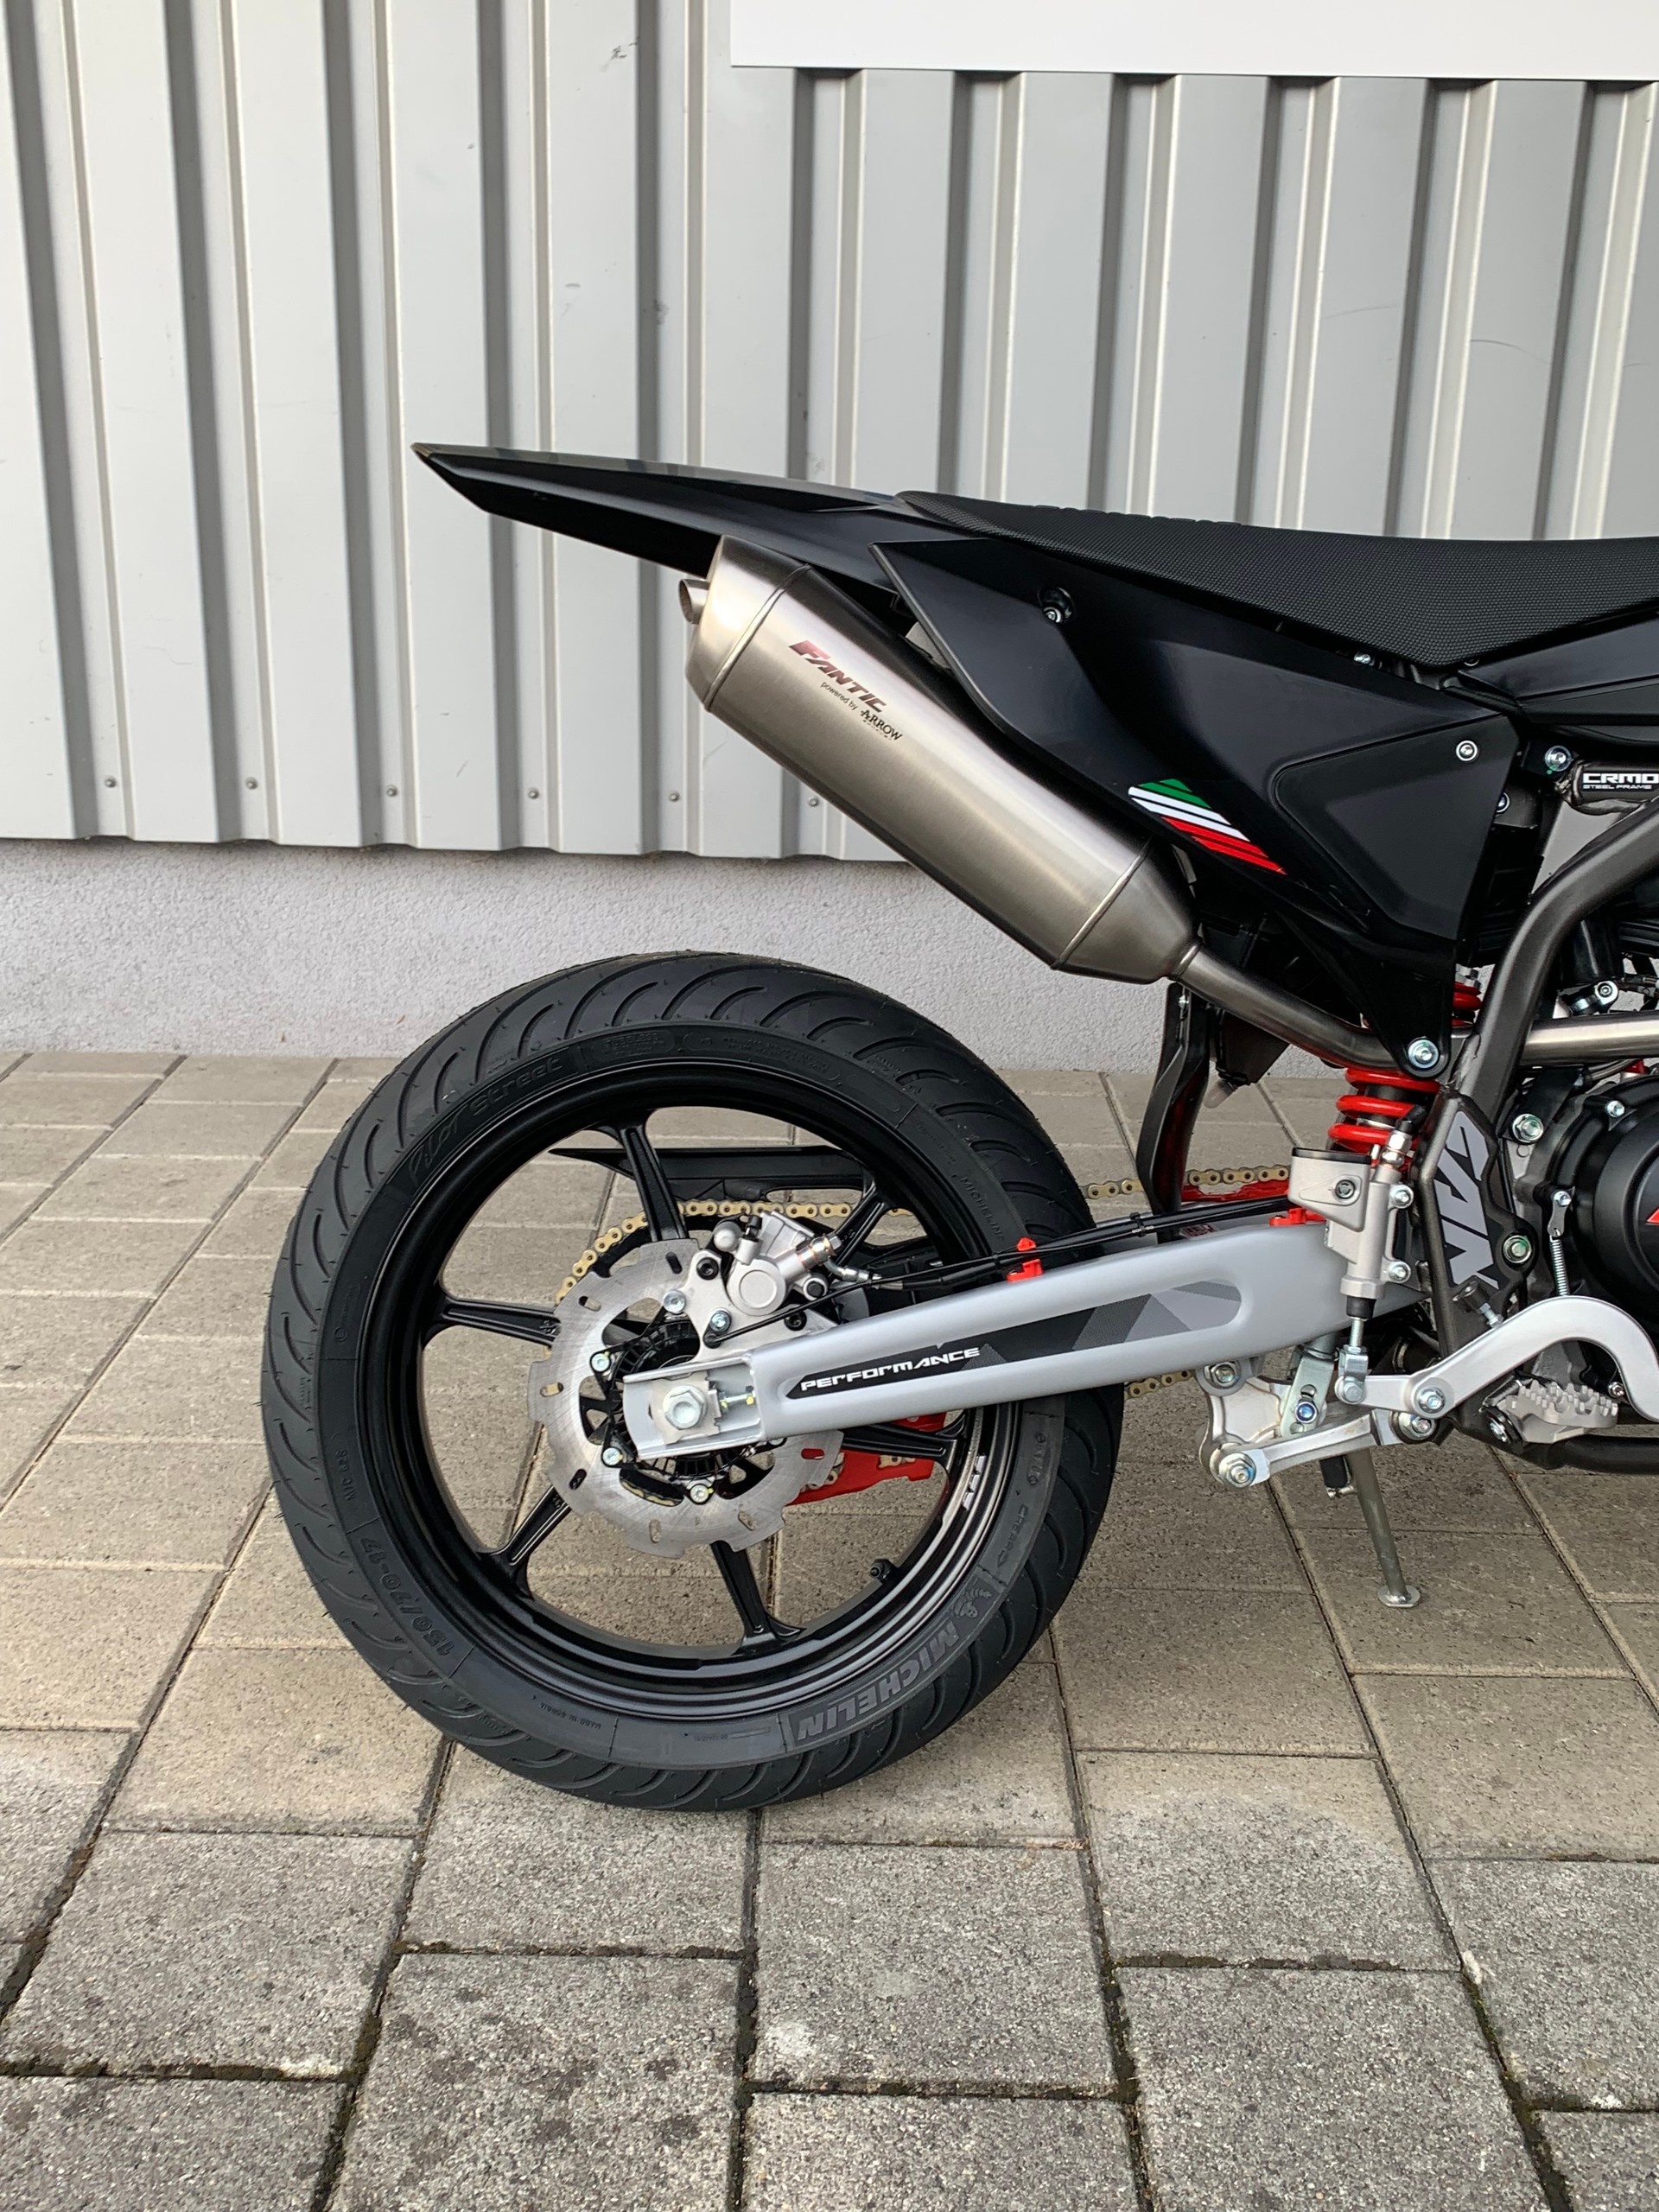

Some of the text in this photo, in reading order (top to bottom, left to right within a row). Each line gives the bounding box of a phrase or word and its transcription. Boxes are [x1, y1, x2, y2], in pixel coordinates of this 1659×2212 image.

[789, 640, 887, 712] FANTIC
[821, 681, 849, 704] powered
[848, 698, 859, 710] by
[860, 709, 903, 741] ARROW
[1583, 773, 1659, 784] CRMO
[466, 1052, 563, 1119] Street
[801, 1347, 980, 1391] PERFORMANCE
[1004, 1516, 1024, 1551] REAR
[797, 1621, 960, 1741] MICHELIN
